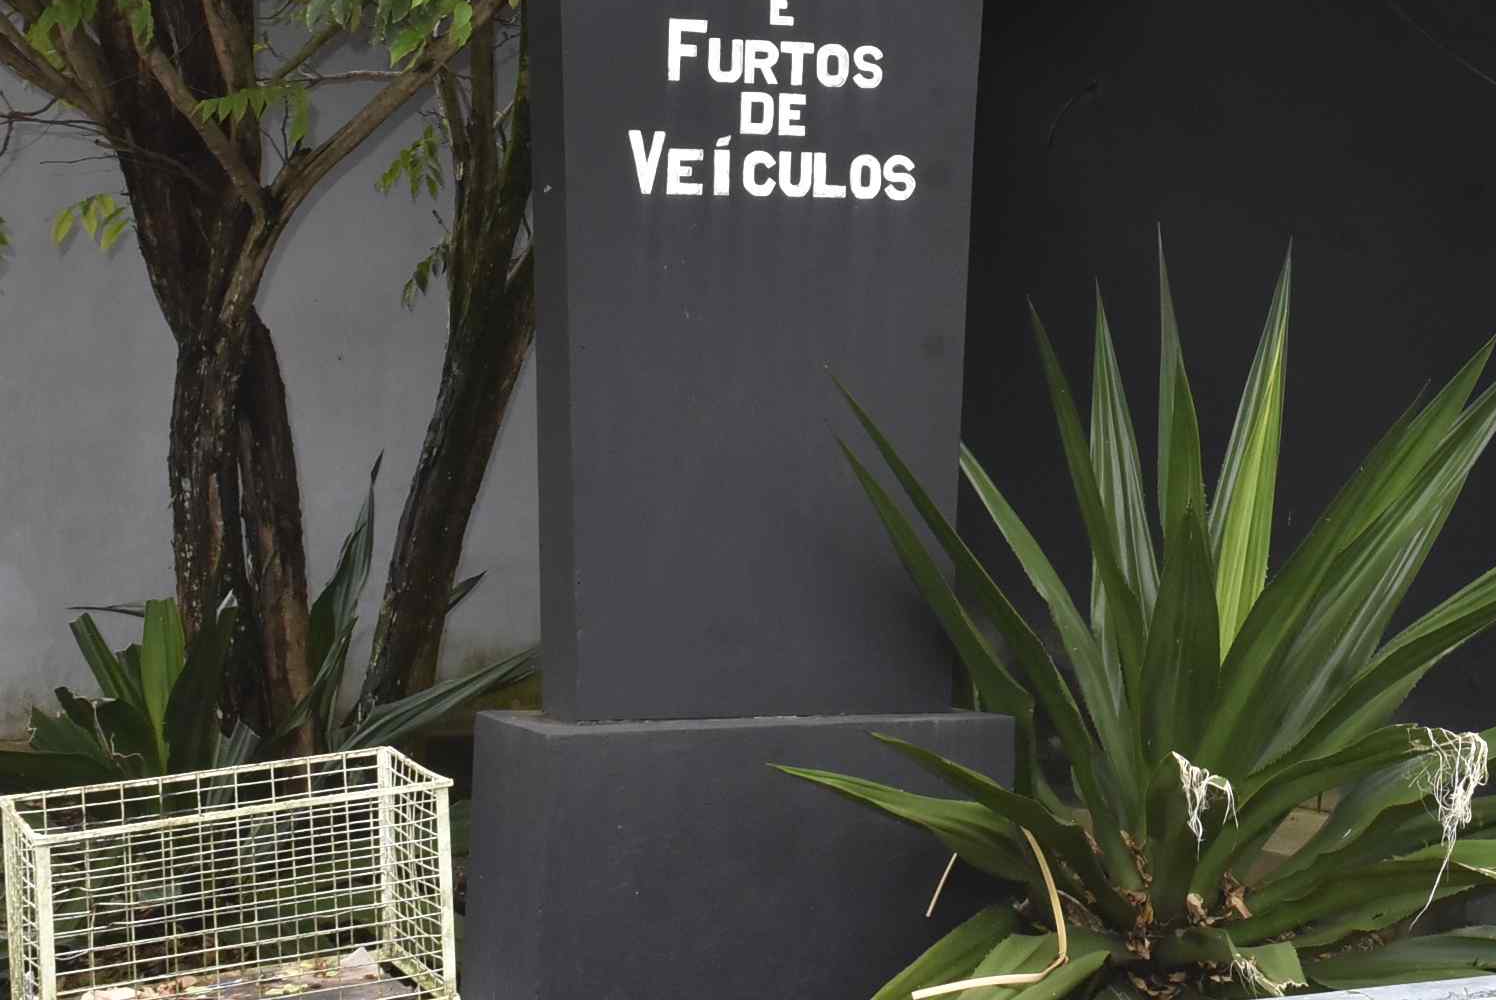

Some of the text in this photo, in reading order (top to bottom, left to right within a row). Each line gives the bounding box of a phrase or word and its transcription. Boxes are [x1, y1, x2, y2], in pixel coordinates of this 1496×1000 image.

[667, 17, 884, 89] FURTOS
[739, 91, 807, 137] DE
[628, 129, 917, 201] VEÍCULOS
